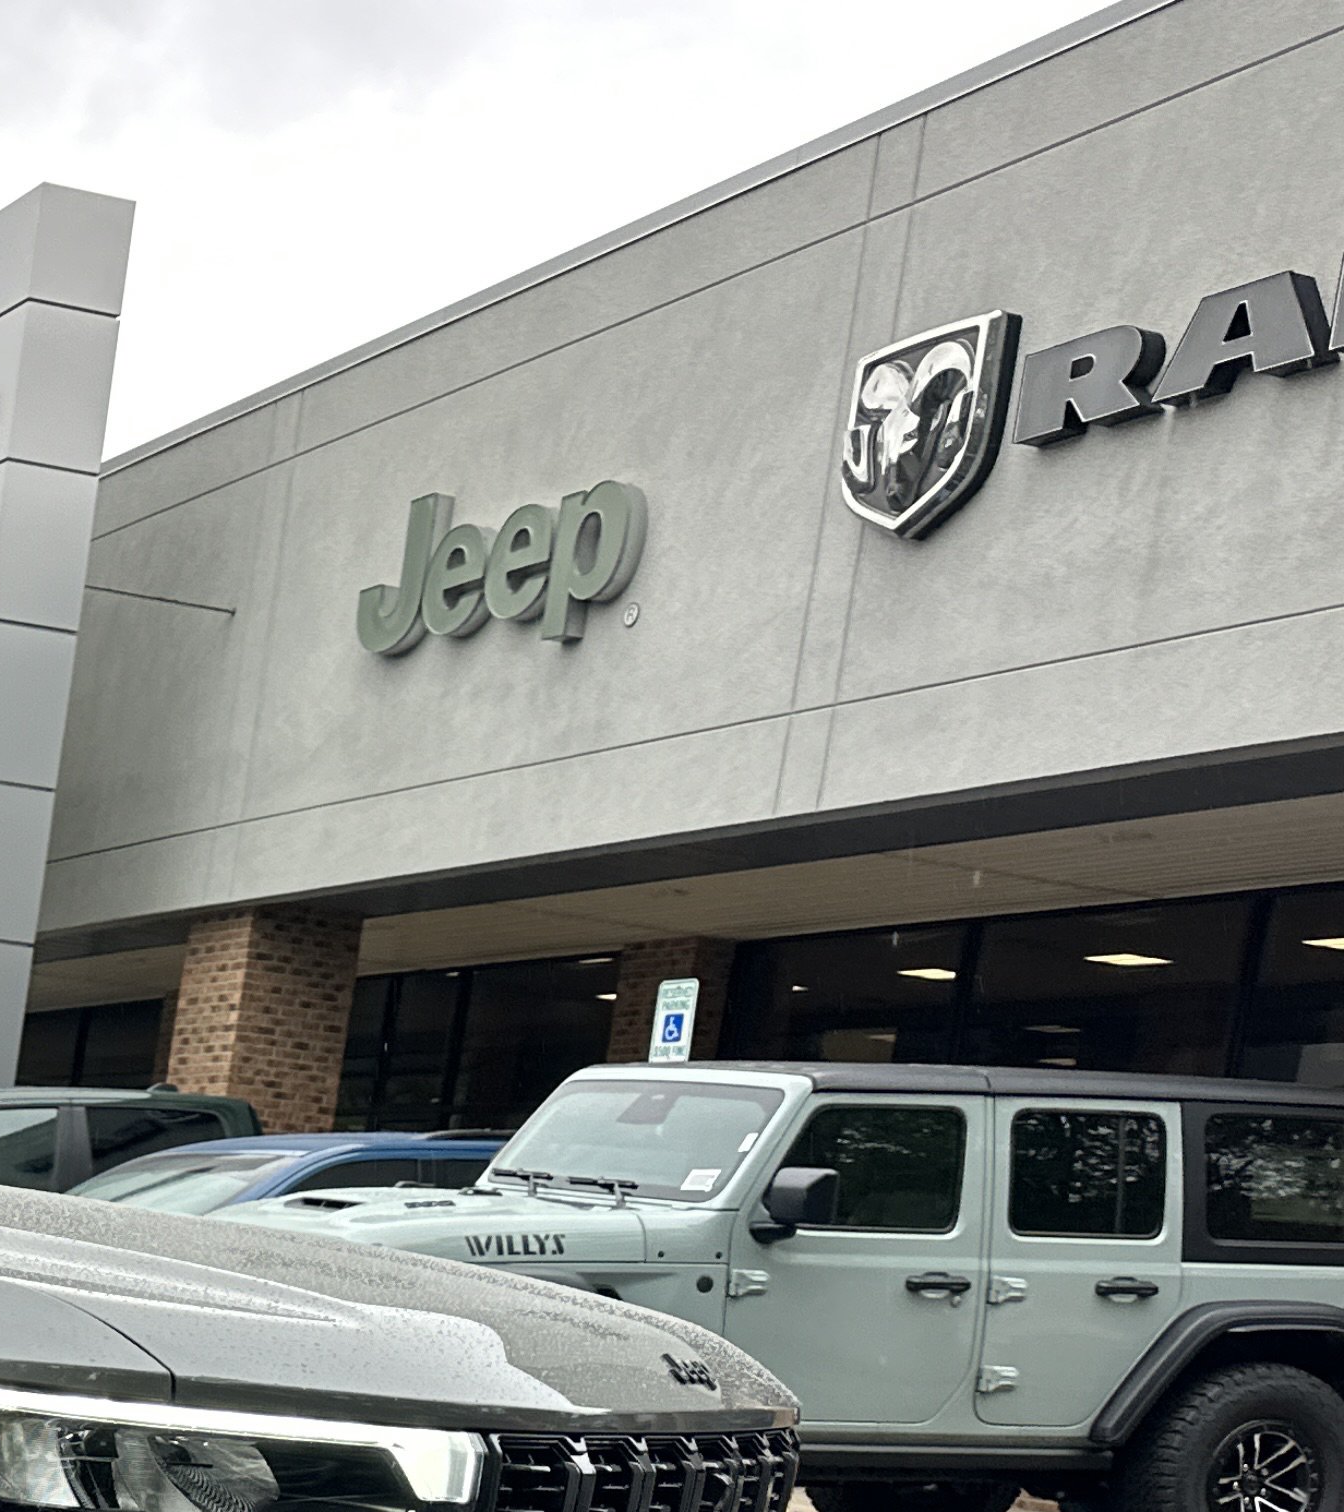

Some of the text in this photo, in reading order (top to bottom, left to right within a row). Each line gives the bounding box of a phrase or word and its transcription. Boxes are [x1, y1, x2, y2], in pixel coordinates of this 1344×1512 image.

[1014, 252, 1344, 448] RA
[356, 480, 648, 656] Jeep
[465, 1233, 566, 1257] WILLYS
